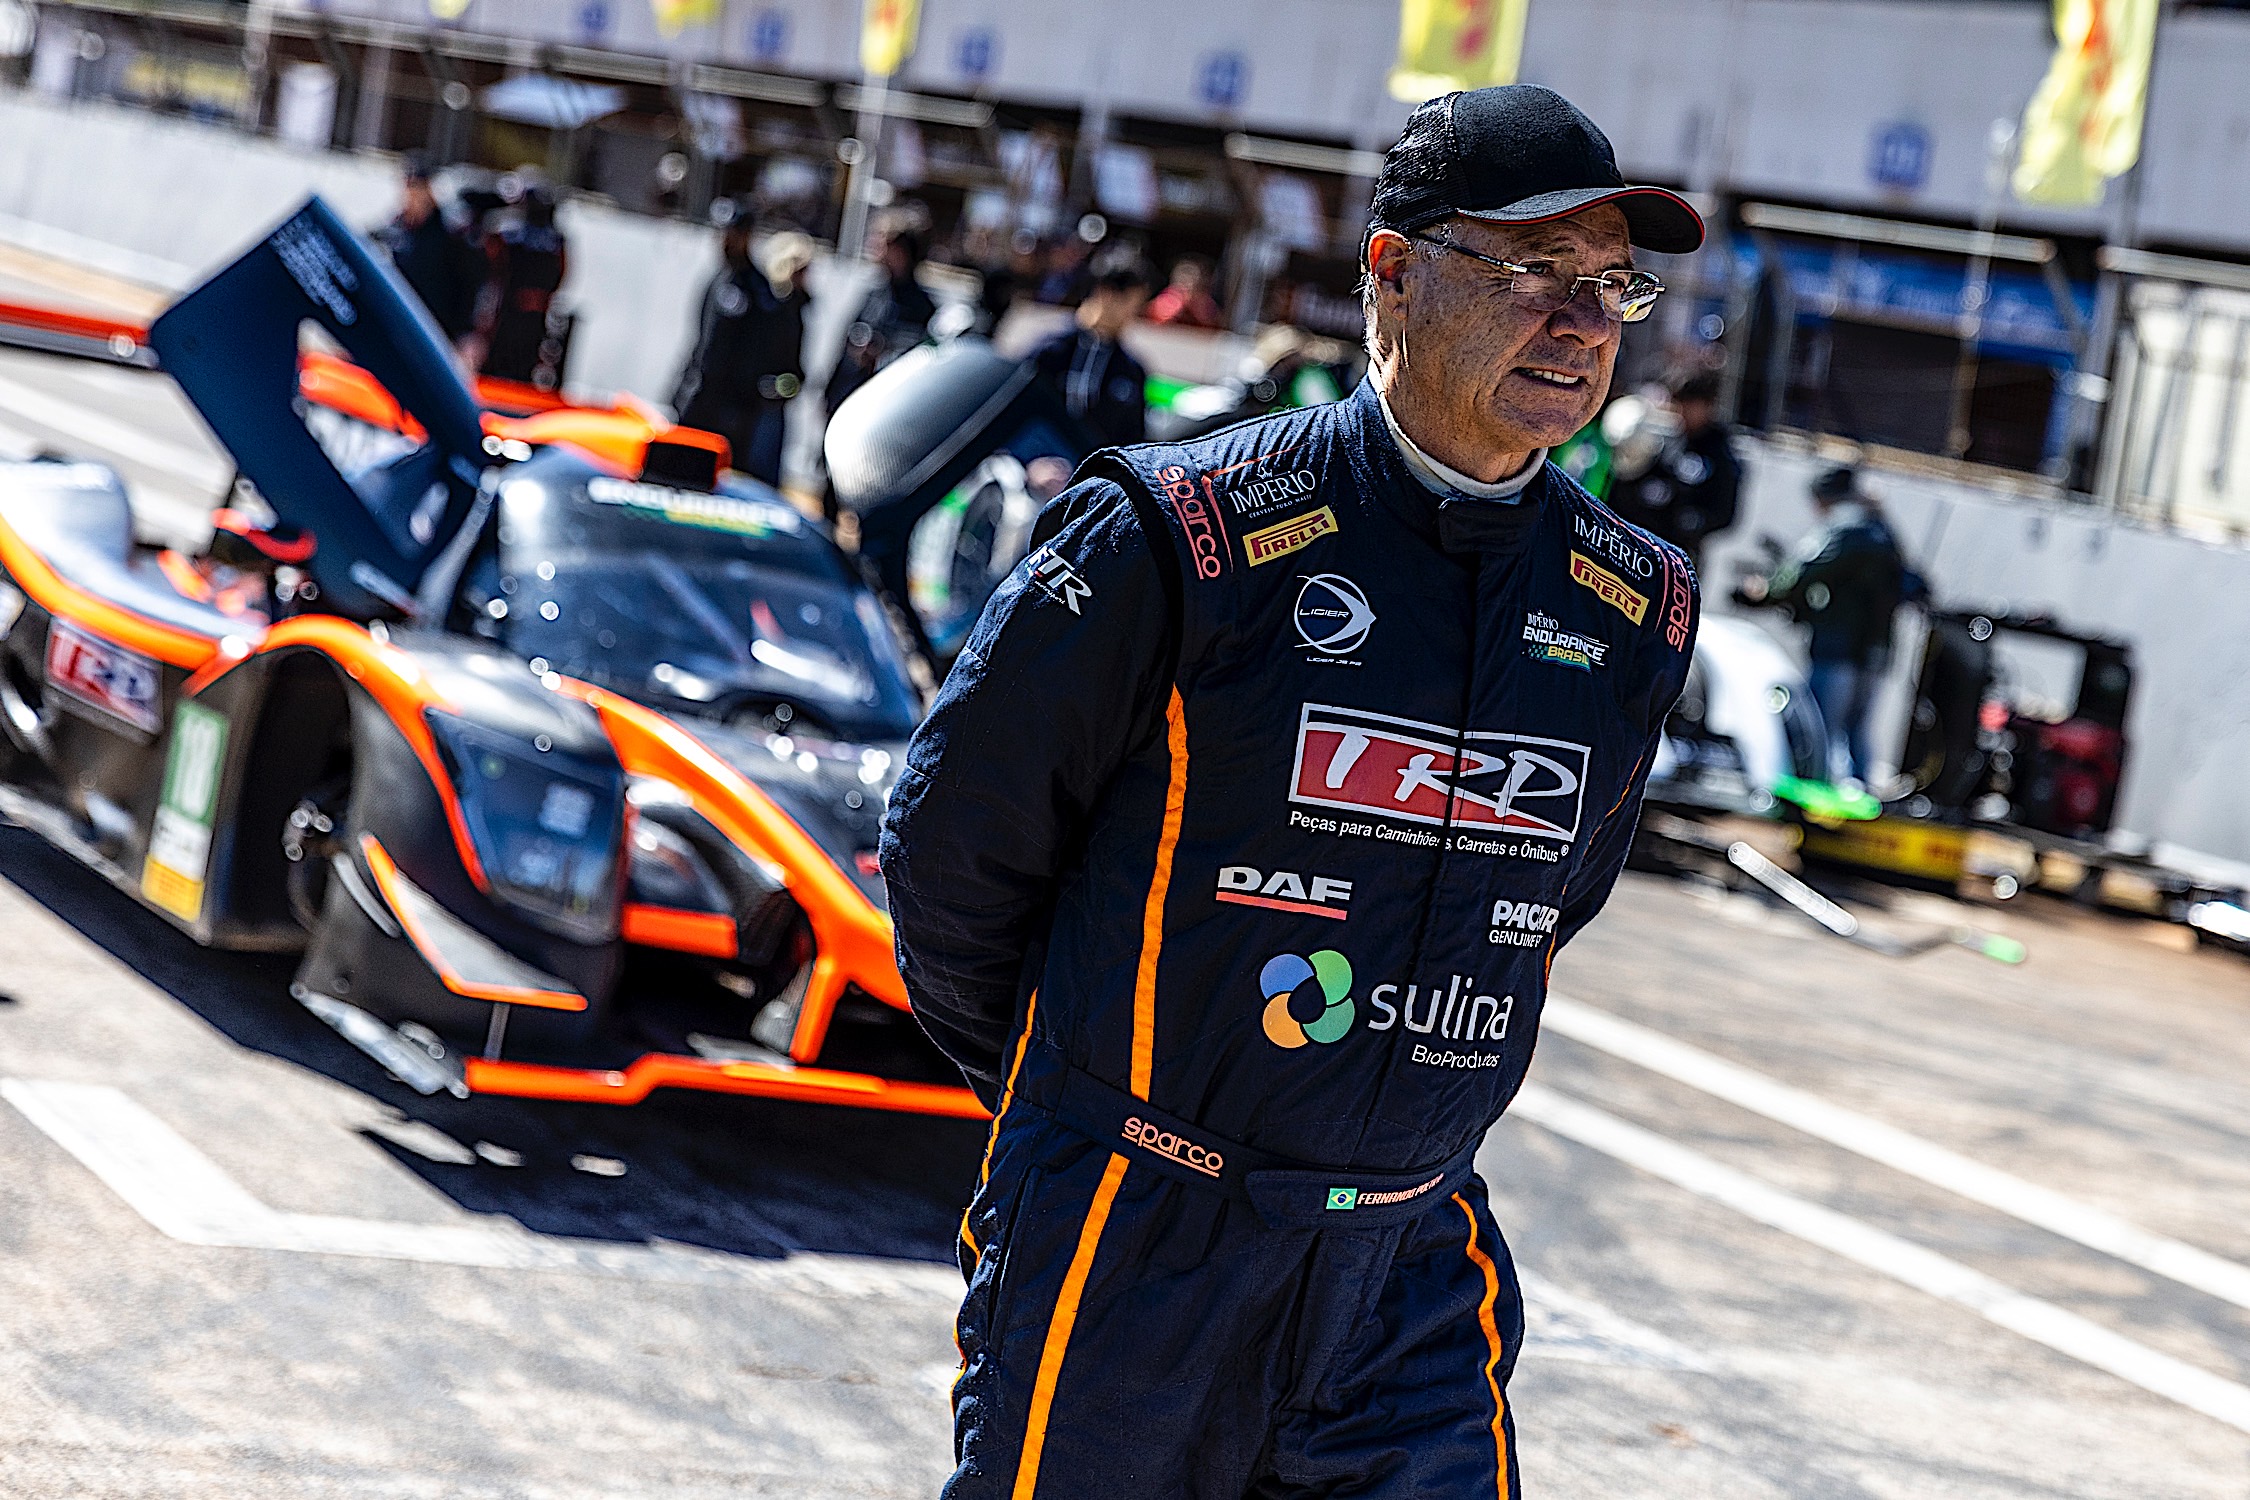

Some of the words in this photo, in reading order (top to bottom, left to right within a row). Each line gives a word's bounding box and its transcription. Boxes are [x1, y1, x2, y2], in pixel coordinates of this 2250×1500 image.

[1154, 465, 1221, 580] sparco
[1249, 512, 1331, 560] PIRELLI
[1573, 557, 1642, 617] PIRELLI
[1299, 608, 1350, 619] LIGIER
[1522, 626, 1606, 661] ENDURANCE
[1547, 645, 1590, 666] BRASIL
[1303, 720, 1580, 830] TRP
[1289, 810, 1337, 834] Peças
[1338, 821, 1373, 838] para
[1508, 844, 1518, 856] e
[1217, 866, 1353, 902] DAF
[1367, 974, 1515, 1041] sulina
[1121, 1116, 1224, 1175] sparco
[1356, 1187, 1418, 1206] FERNANDO
